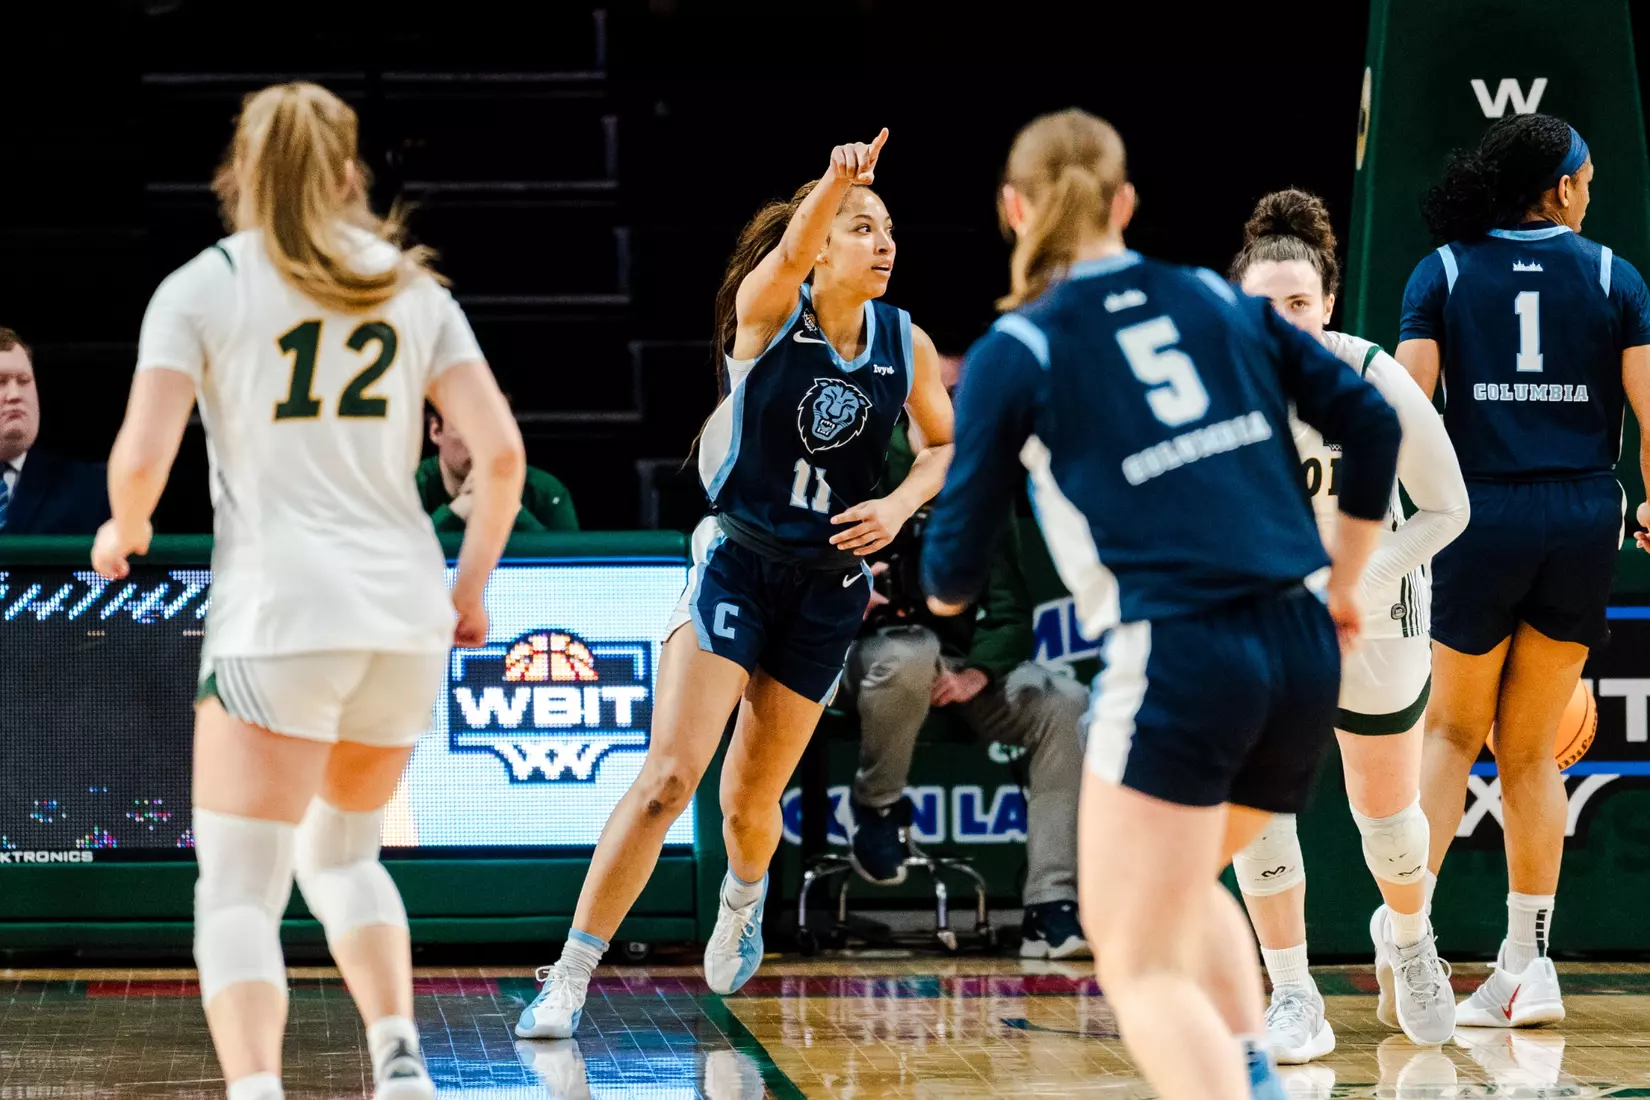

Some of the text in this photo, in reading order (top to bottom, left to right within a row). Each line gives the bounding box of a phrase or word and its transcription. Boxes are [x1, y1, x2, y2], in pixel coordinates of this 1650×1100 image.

[1515, 291, 1544, 372] 1
[274, 319, 398, 421] 12
[1115, 315, 1211, 428] 5
[1473, 383, 1589, 402] COLUMBIA
[789, 457, 831, 514] 11
[453, 686, 649, 728] WBIT
